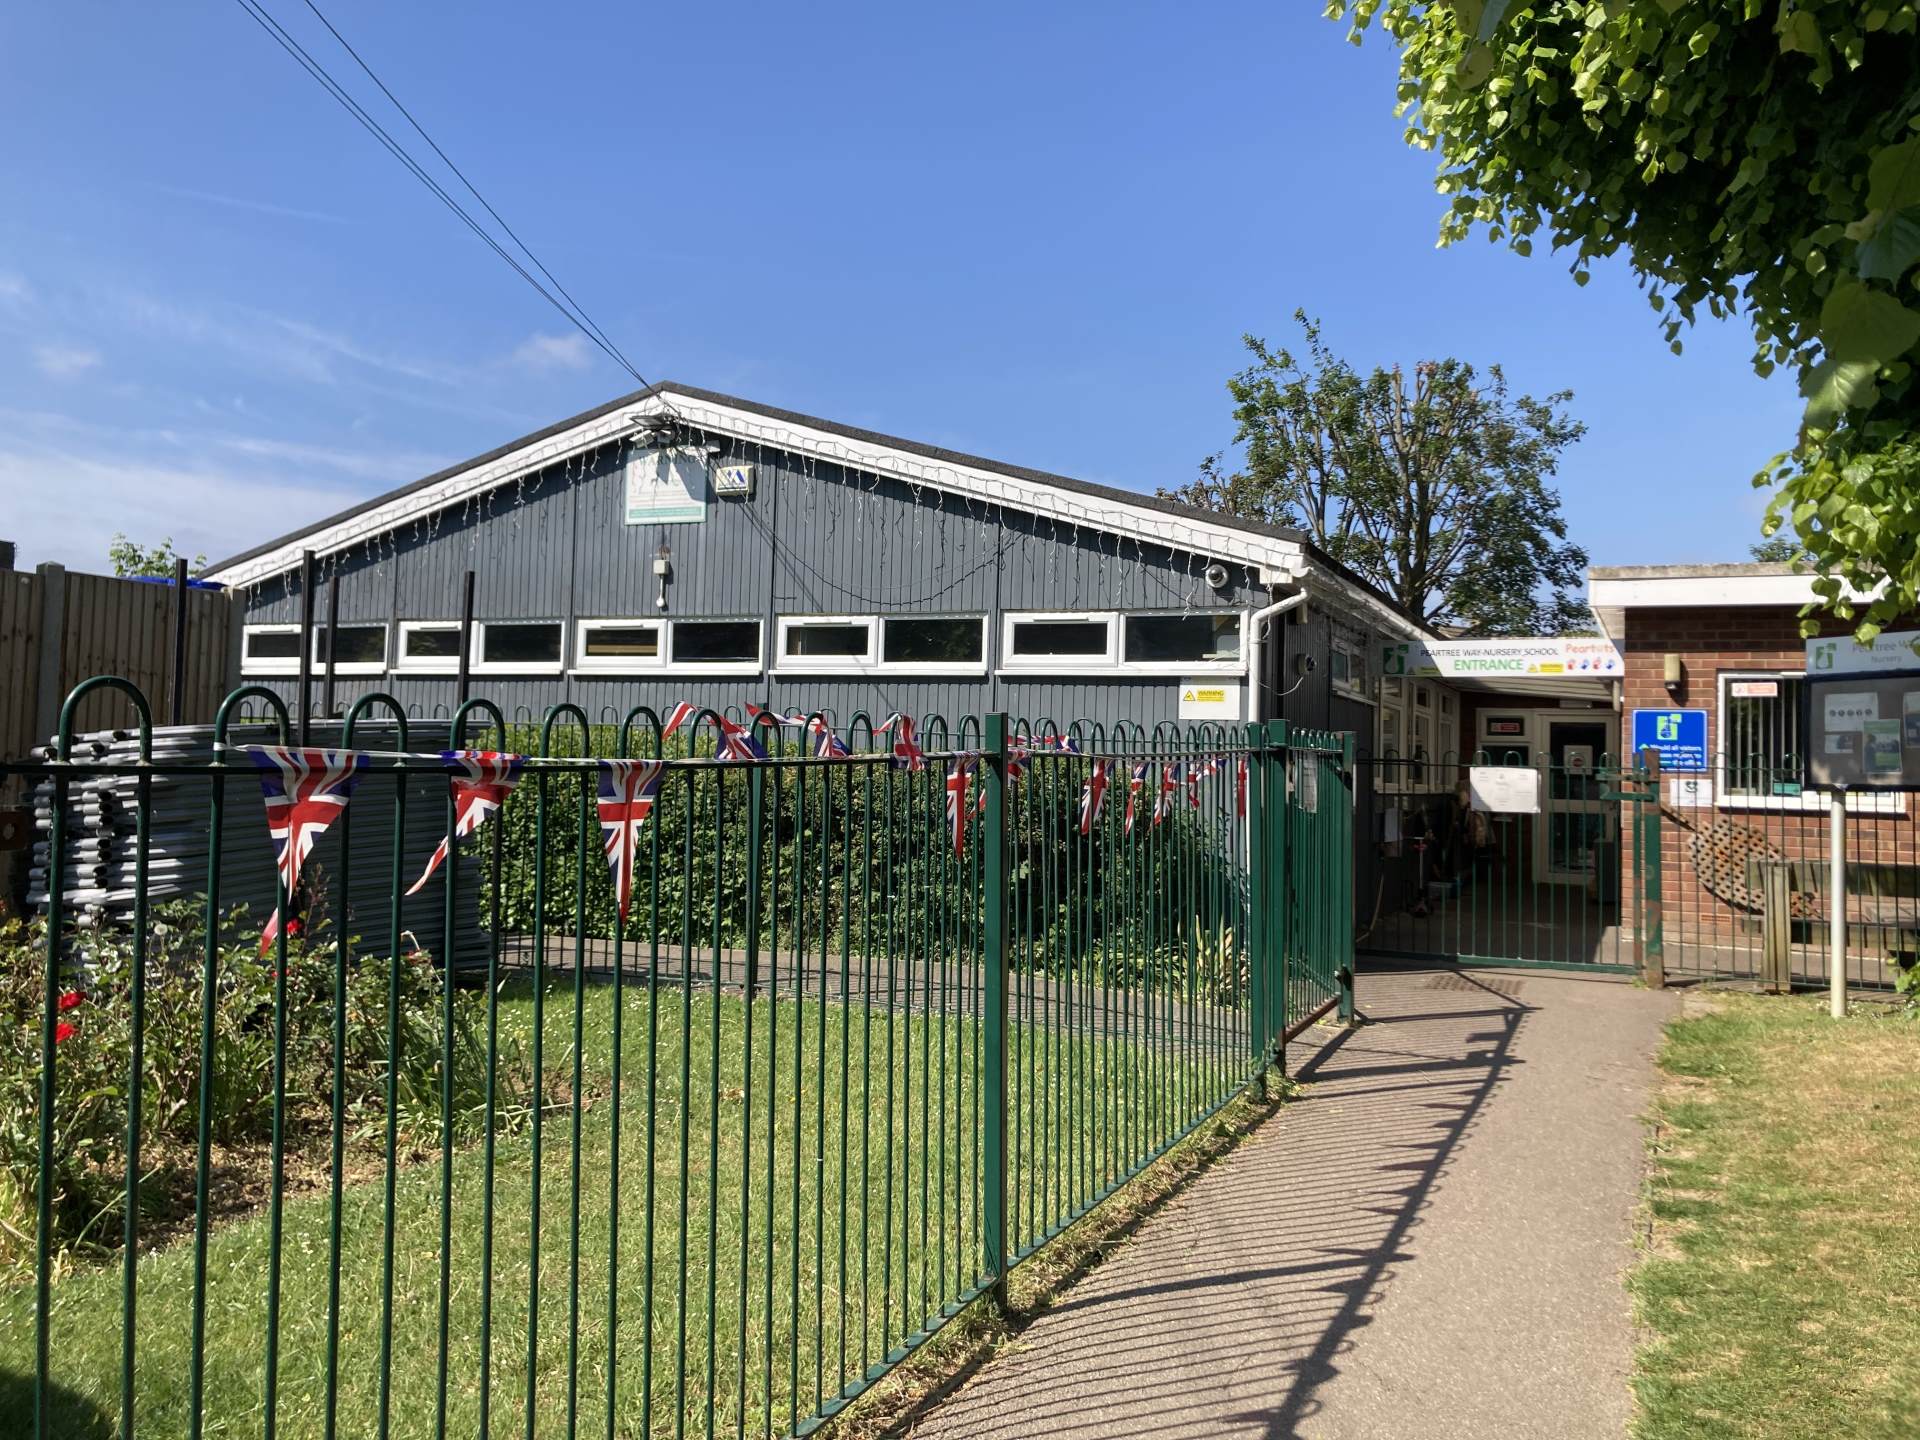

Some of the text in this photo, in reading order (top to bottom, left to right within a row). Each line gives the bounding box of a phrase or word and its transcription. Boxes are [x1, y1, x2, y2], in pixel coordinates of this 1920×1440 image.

[1420, 649, 1461, 657] PEARTREE
[1523, 647, 1559, 656] SCHOOL
[1852, 643, 1897, 653] Petree
[1454, 658, 1524, 671] ENTRANCE
